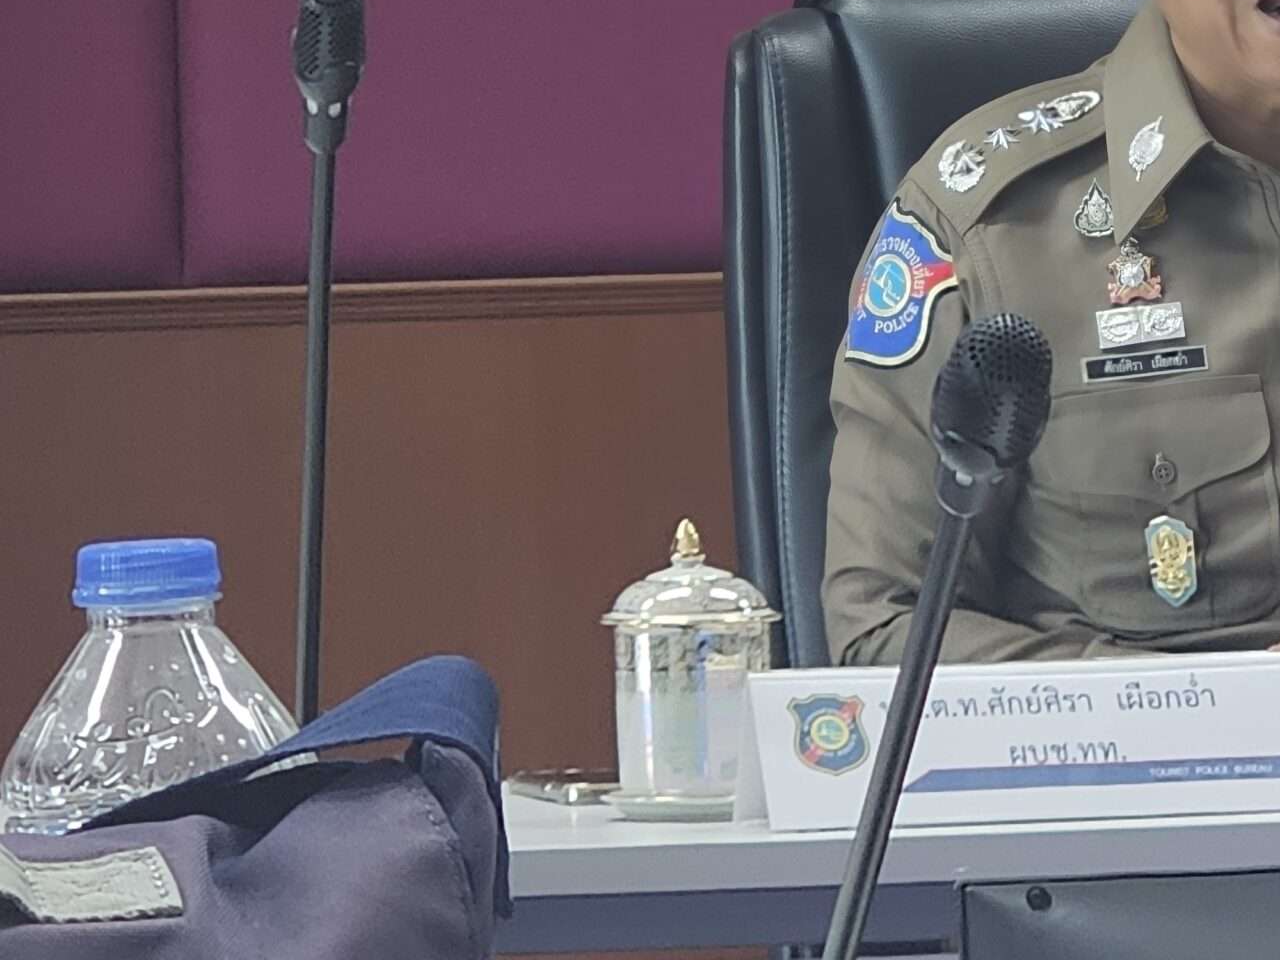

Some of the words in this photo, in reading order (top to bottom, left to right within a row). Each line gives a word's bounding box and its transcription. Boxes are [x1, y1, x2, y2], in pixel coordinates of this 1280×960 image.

[873, 300, 920, 334] POLICE
[878, 683, 1094, 721] .ต.ท.ศักย์ศิรา
